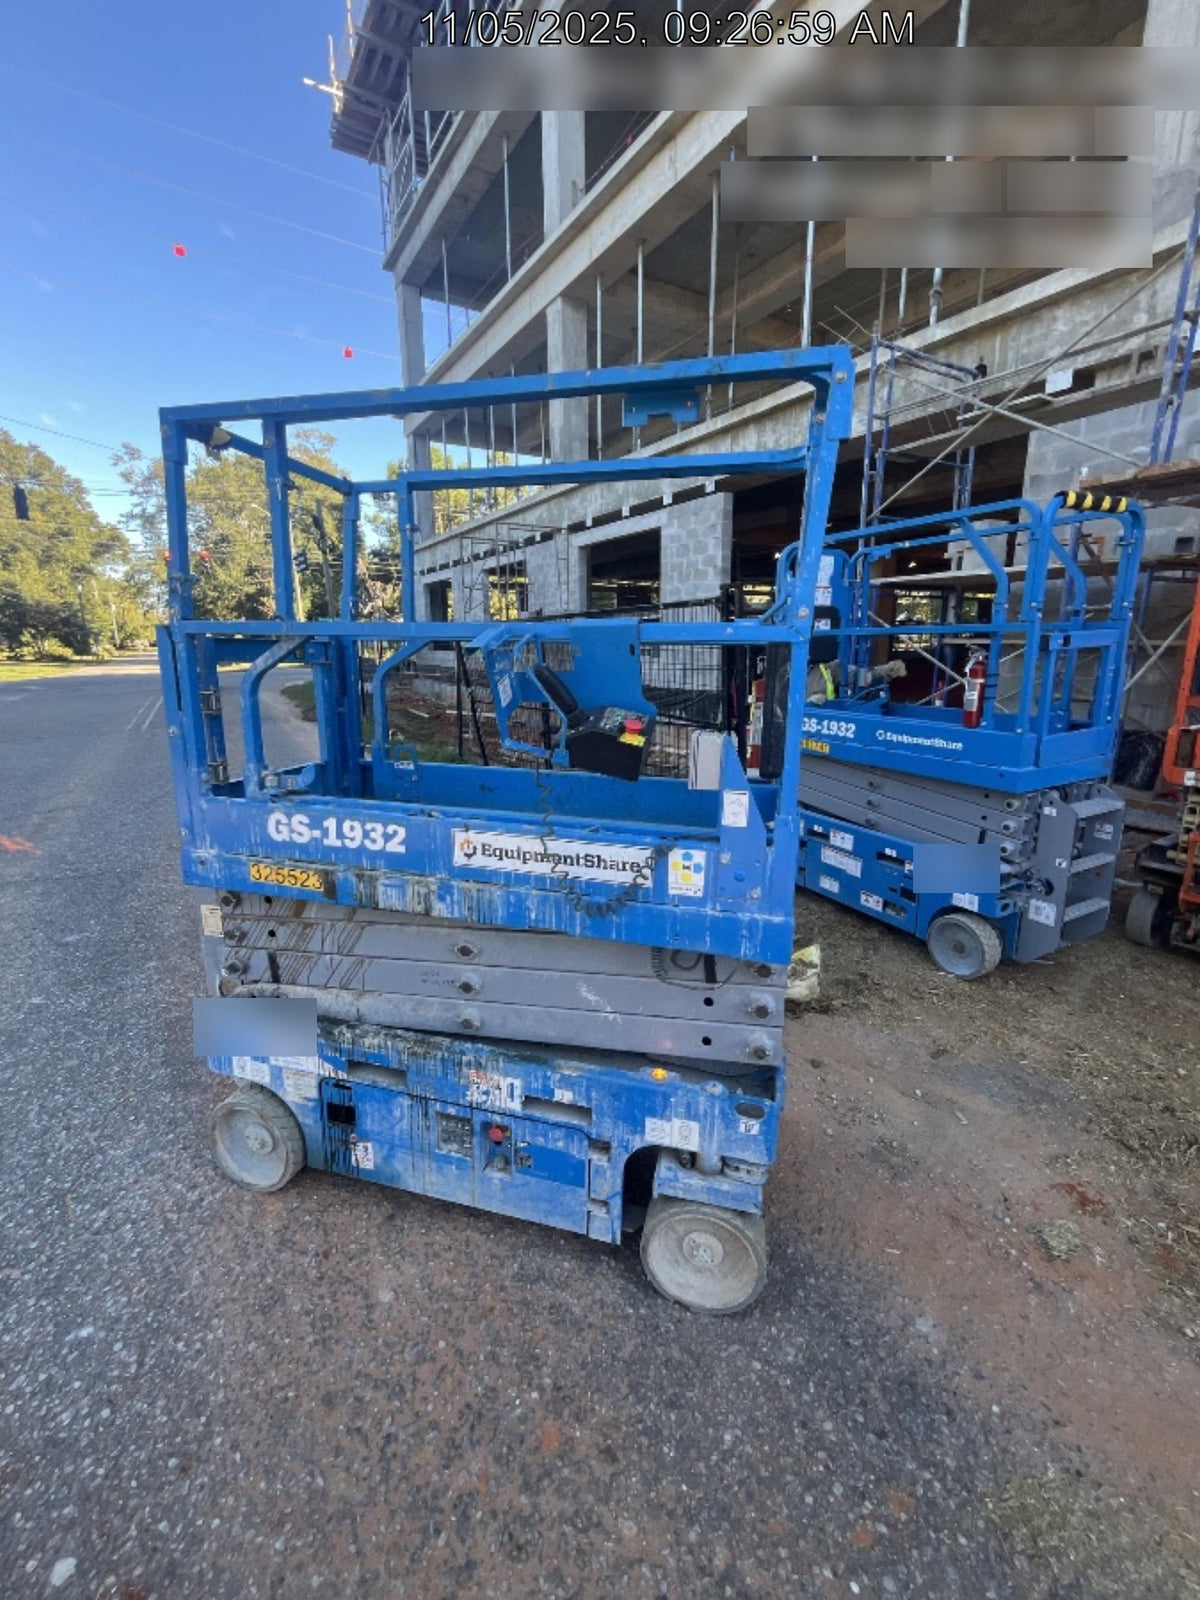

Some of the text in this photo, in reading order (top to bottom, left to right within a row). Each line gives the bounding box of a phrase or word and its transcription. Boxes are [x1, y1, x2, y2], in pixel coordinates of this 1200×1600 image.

[886, 730, 963, 750] EquipmentShare
[267, 811, 407, 853] GS-1932
[480, 842, 643, 873] EquipmentShare
[251, 863, 323, 889] 325523
